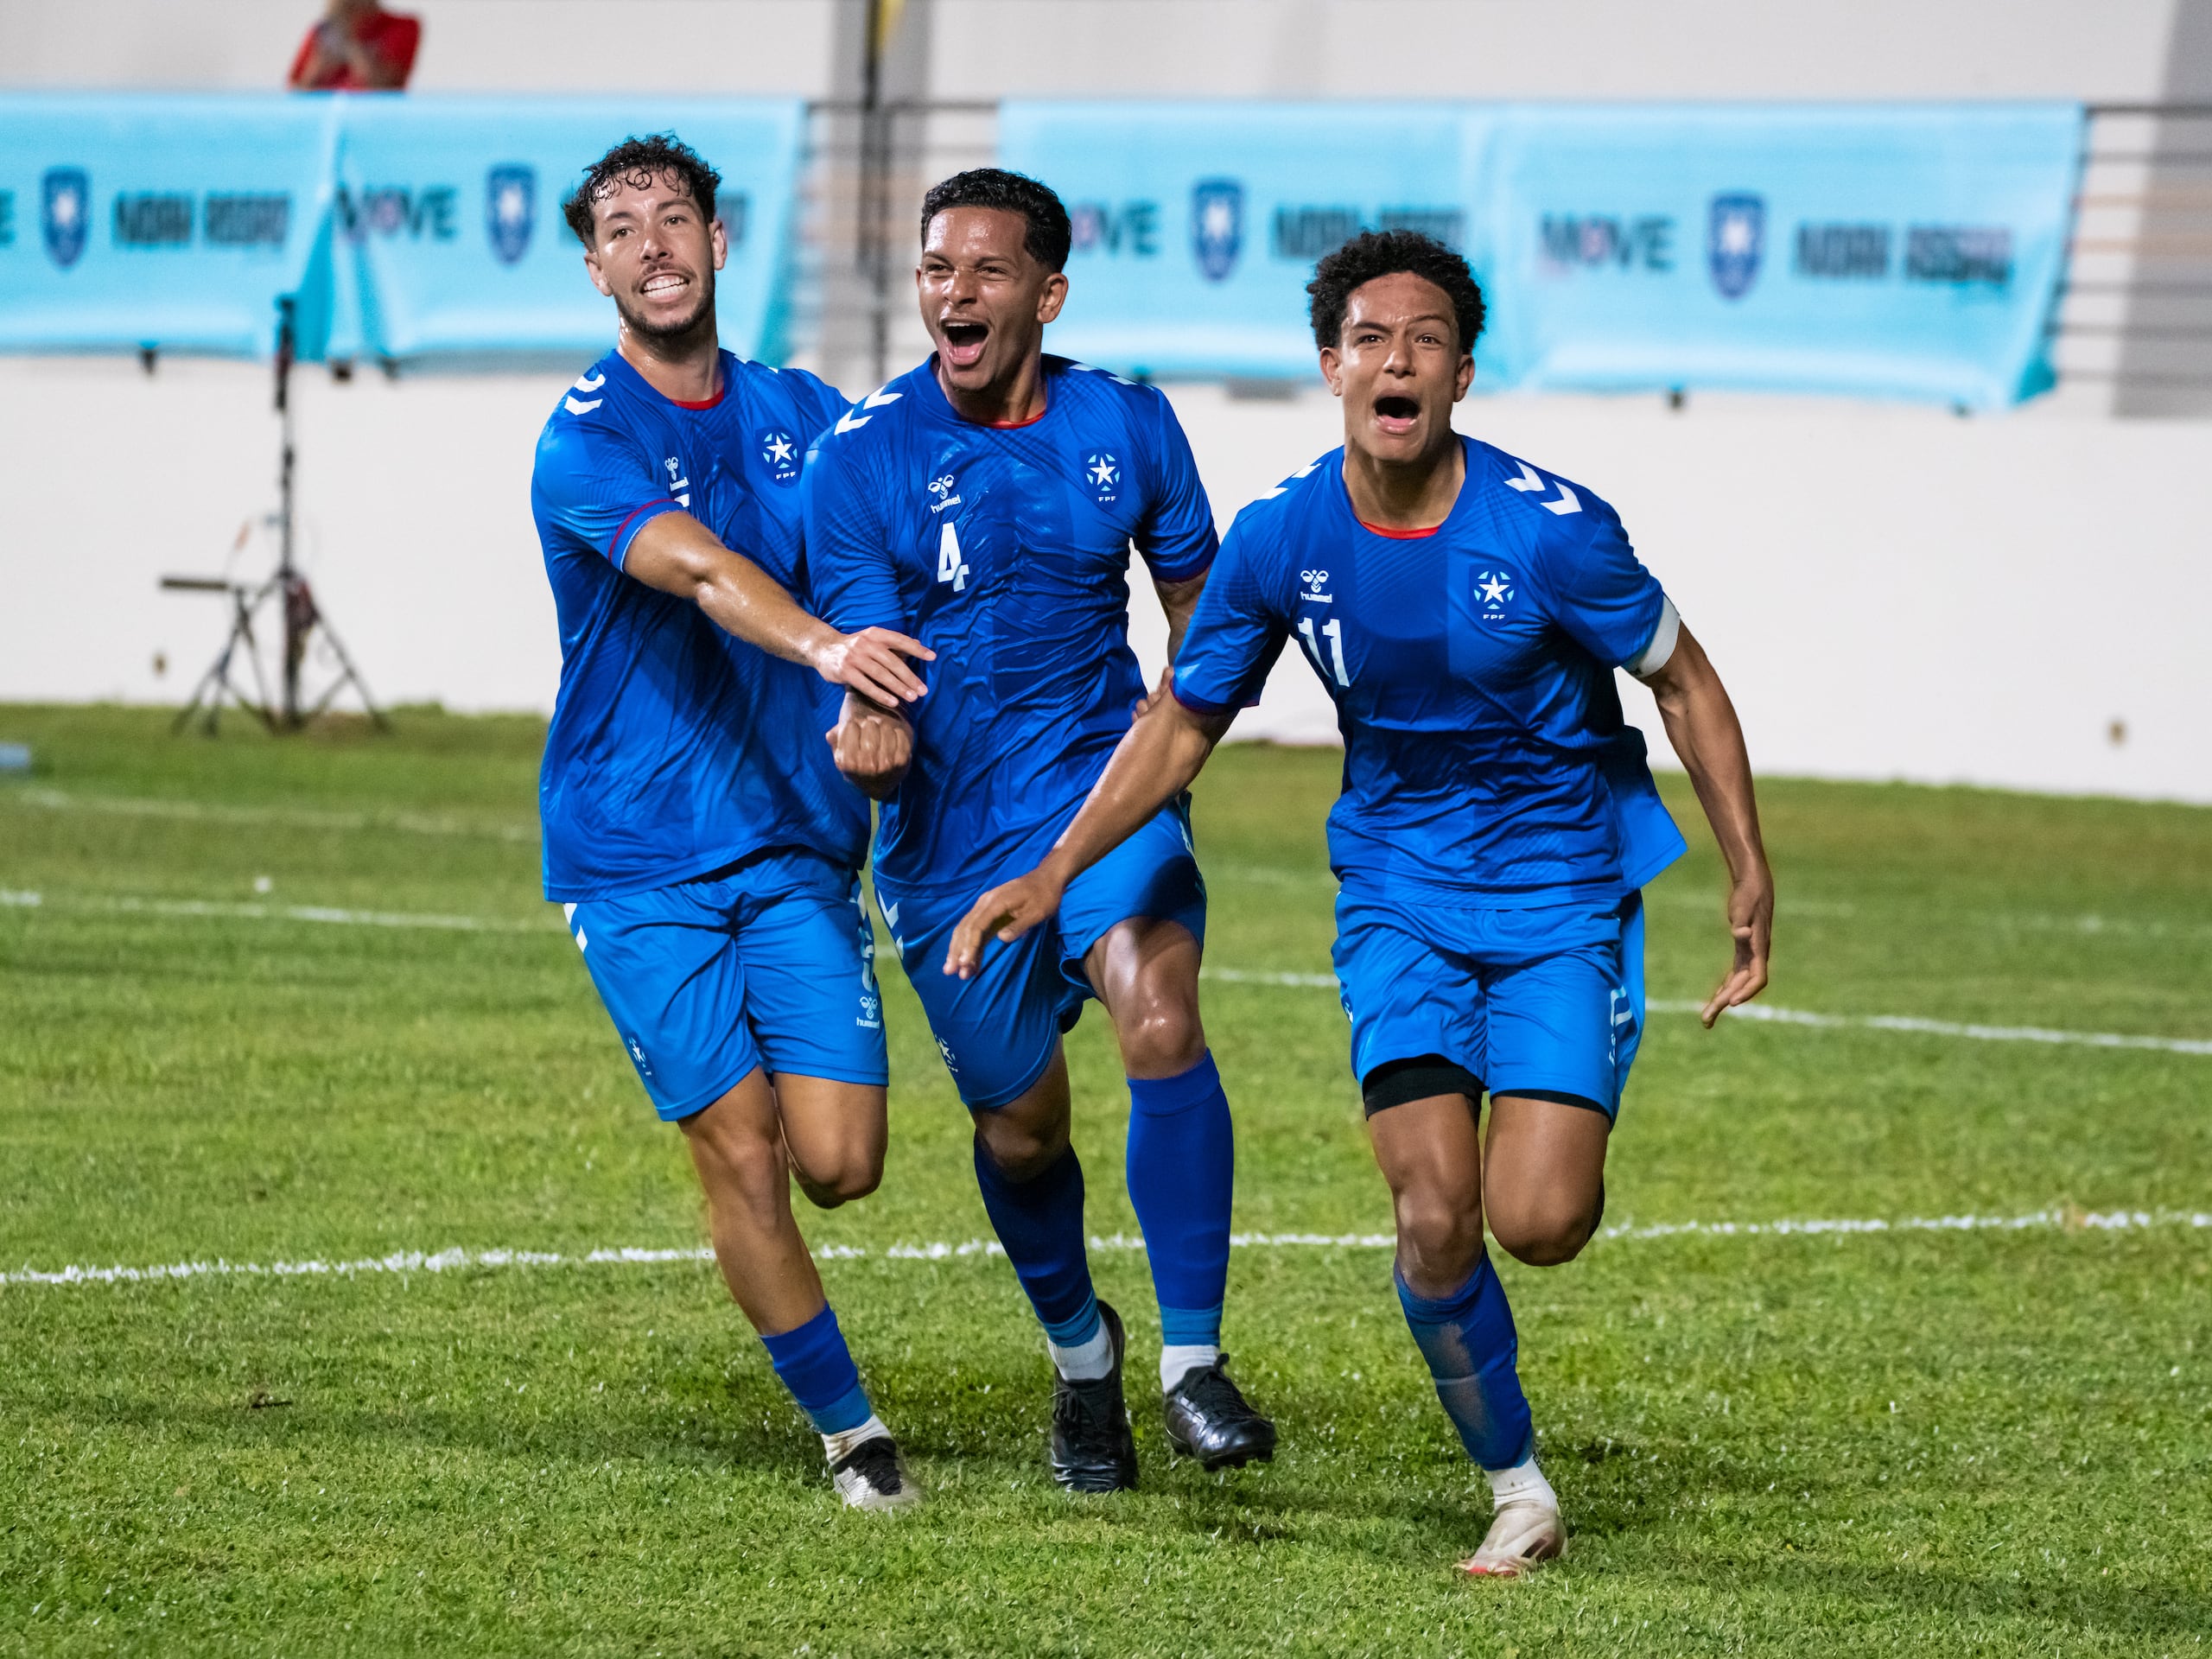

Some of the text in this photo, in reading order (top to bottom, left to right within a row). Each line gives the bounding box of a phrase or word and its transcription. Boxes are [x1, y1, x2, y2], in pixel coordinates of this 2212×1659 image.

[1070, 200, 1160, 257] OVE
[775, 471, 797, 480] FPF
[938, 521, 970, 593] 4
[1297, 616, 1351, 688] 11
